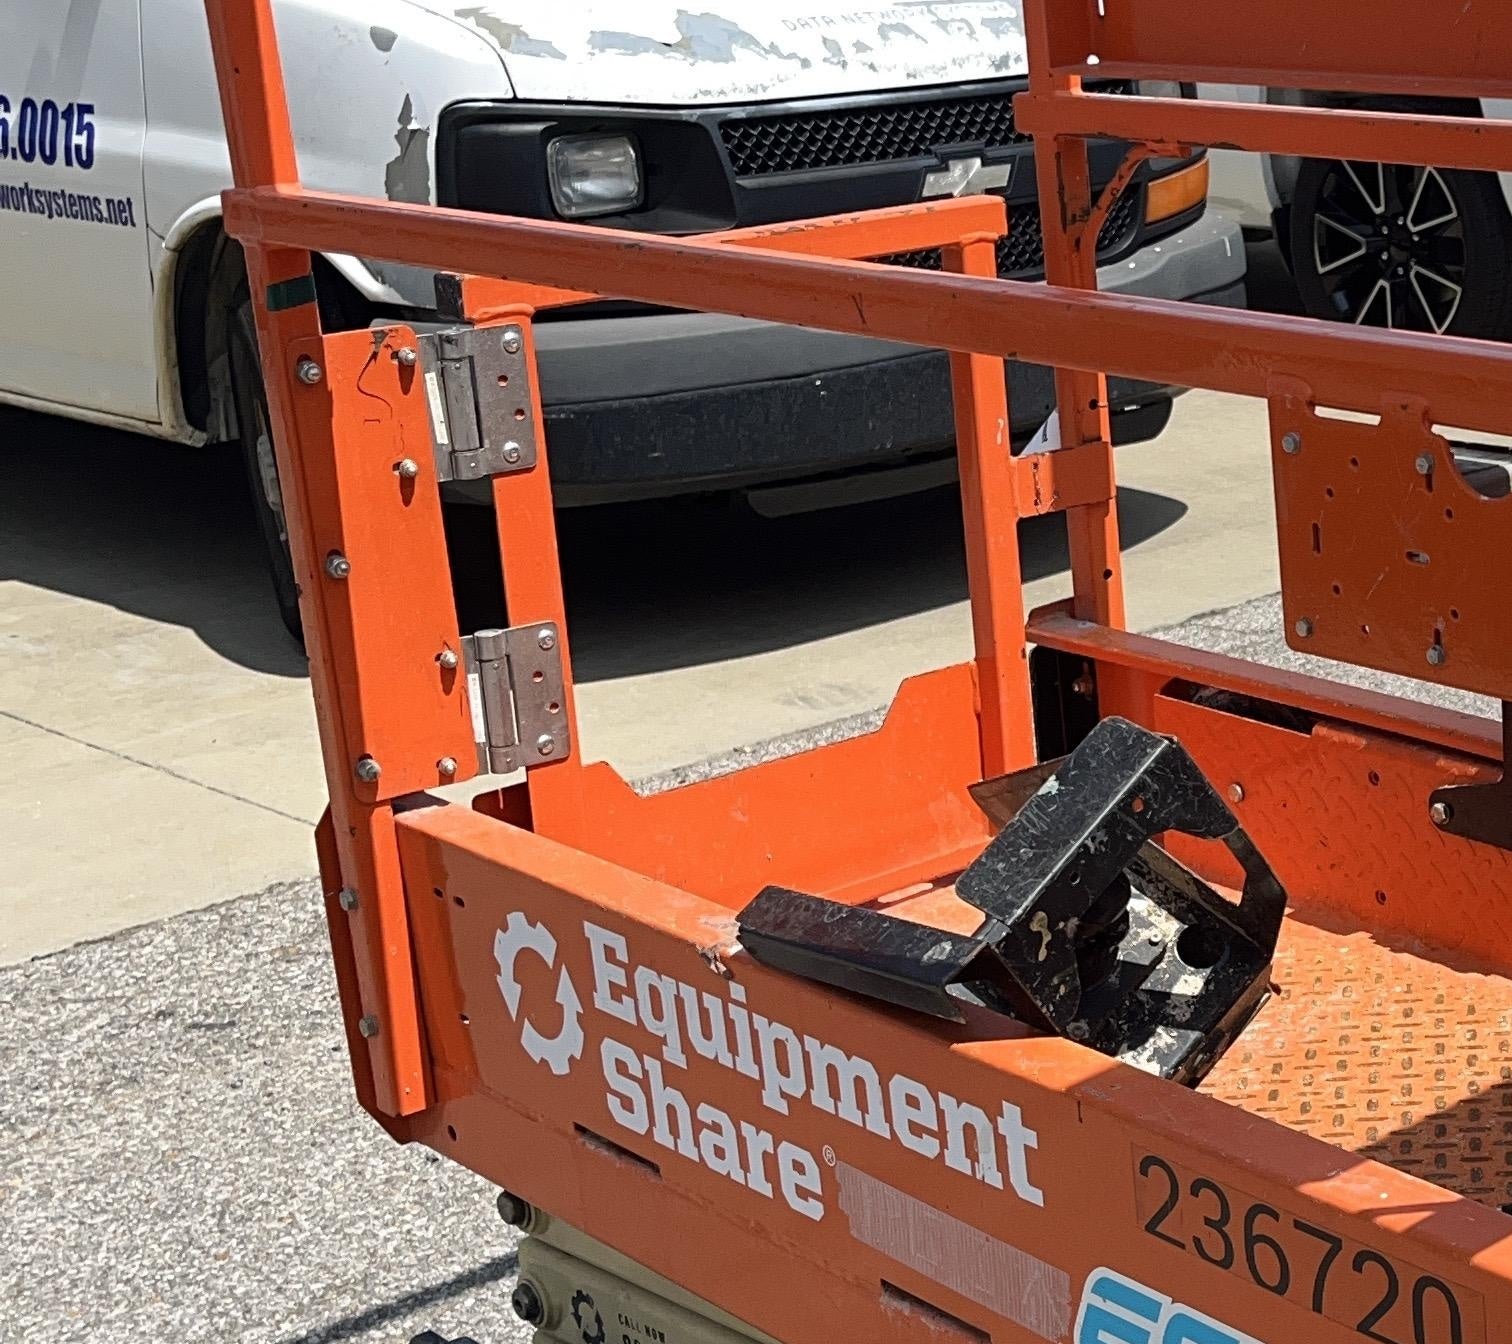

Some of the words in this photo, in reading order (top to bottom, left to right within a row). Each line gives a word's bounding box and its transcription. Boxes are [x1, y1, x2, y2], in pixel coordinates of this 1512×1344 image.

[583, 921, 1044, 1207] Equipment
[601, 1036, 826, 1222] Share
[618, 1312, 641, 1334] CALL
[645, 1324, 666, 1344] NOW
